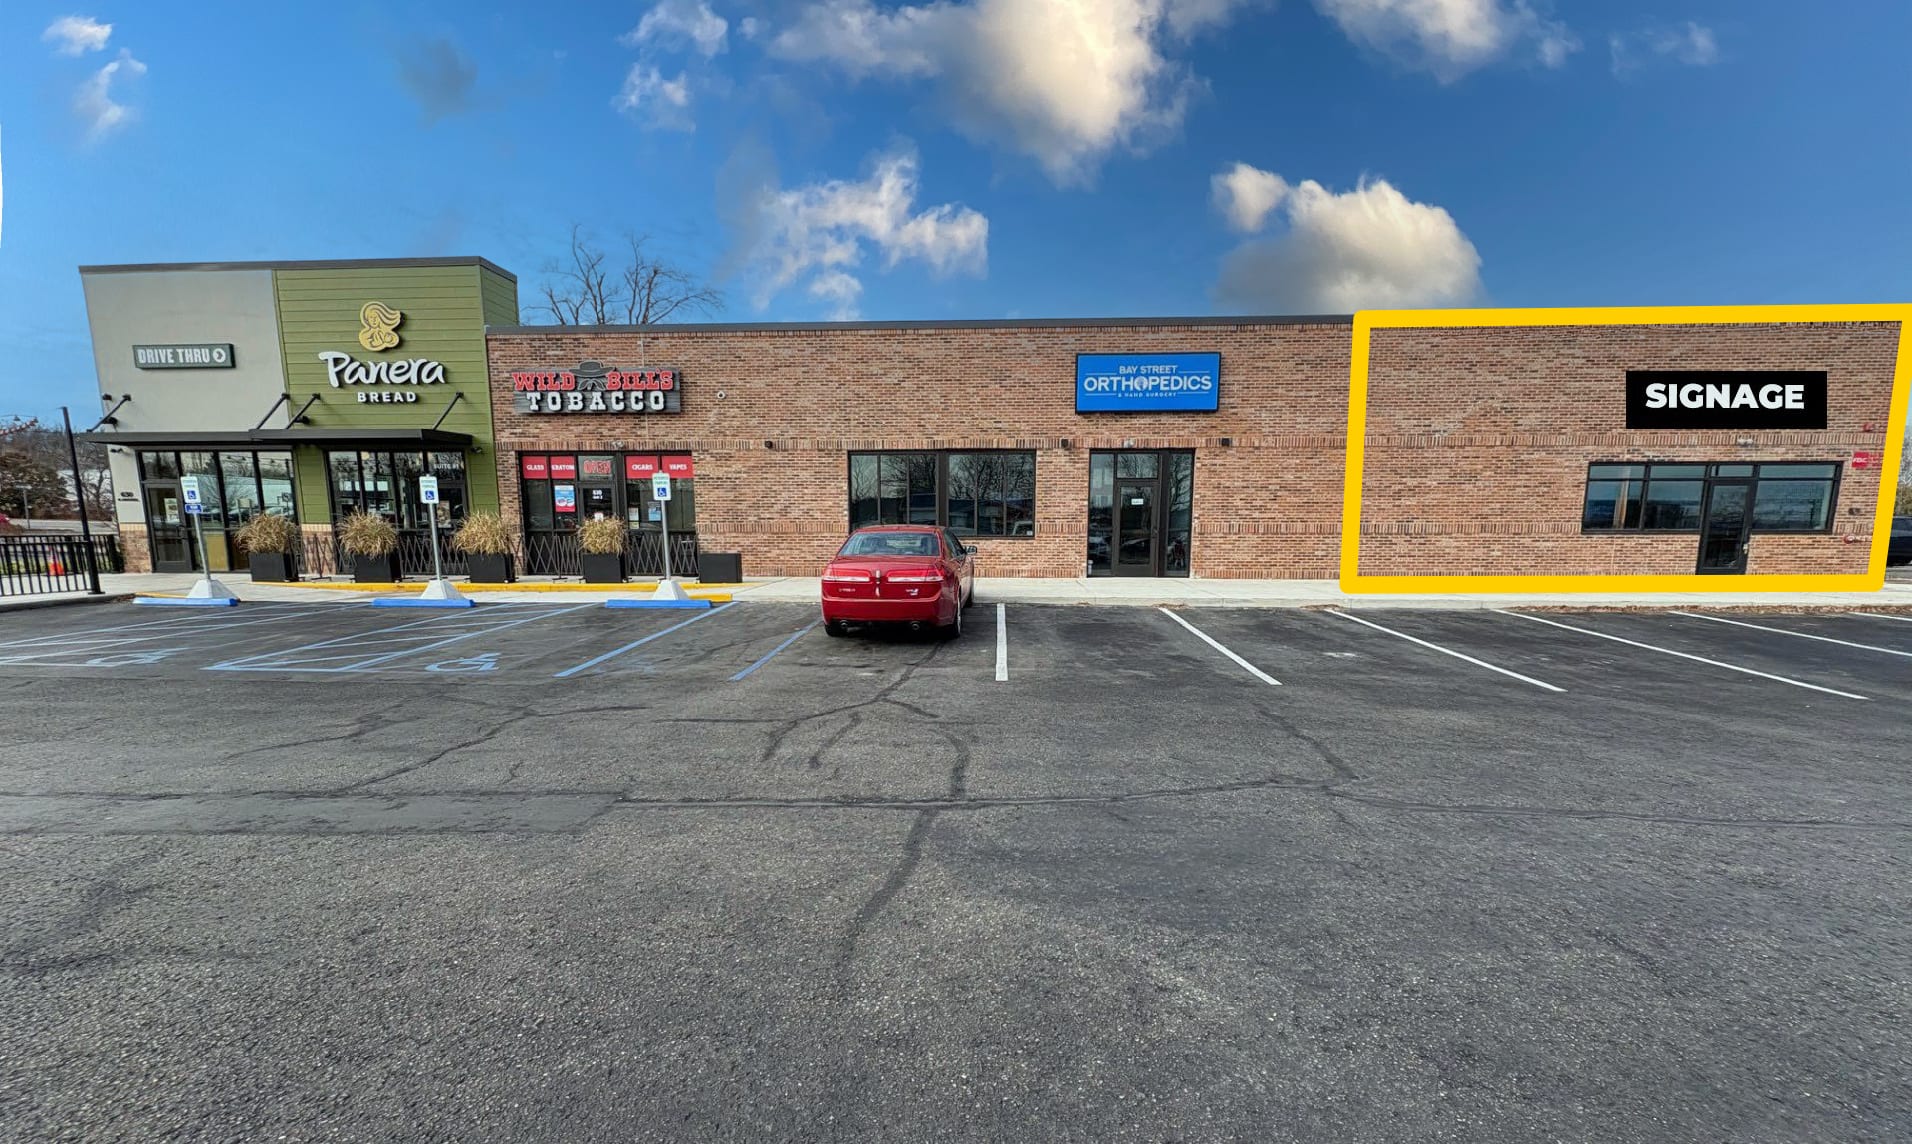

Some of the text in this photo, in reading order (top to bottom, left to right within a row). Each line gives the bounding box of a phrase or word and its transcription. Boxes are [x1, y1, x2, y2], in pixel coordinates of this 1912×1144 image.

[137, 347, 211, 363] DRIVE THRU
[318, 350, 446, 388] Panera
[1119, 365, 1178, 374] BAY STREET
[512, 368, 674, 391] WILD BILL'S
[1083, 375, 1212, 392] ORTHOPEDICS
[357, 391, 417, 402] BREAD
[526, 390, 665, 411] TOBACCO
[583, 460, 611, 474] OPEN
